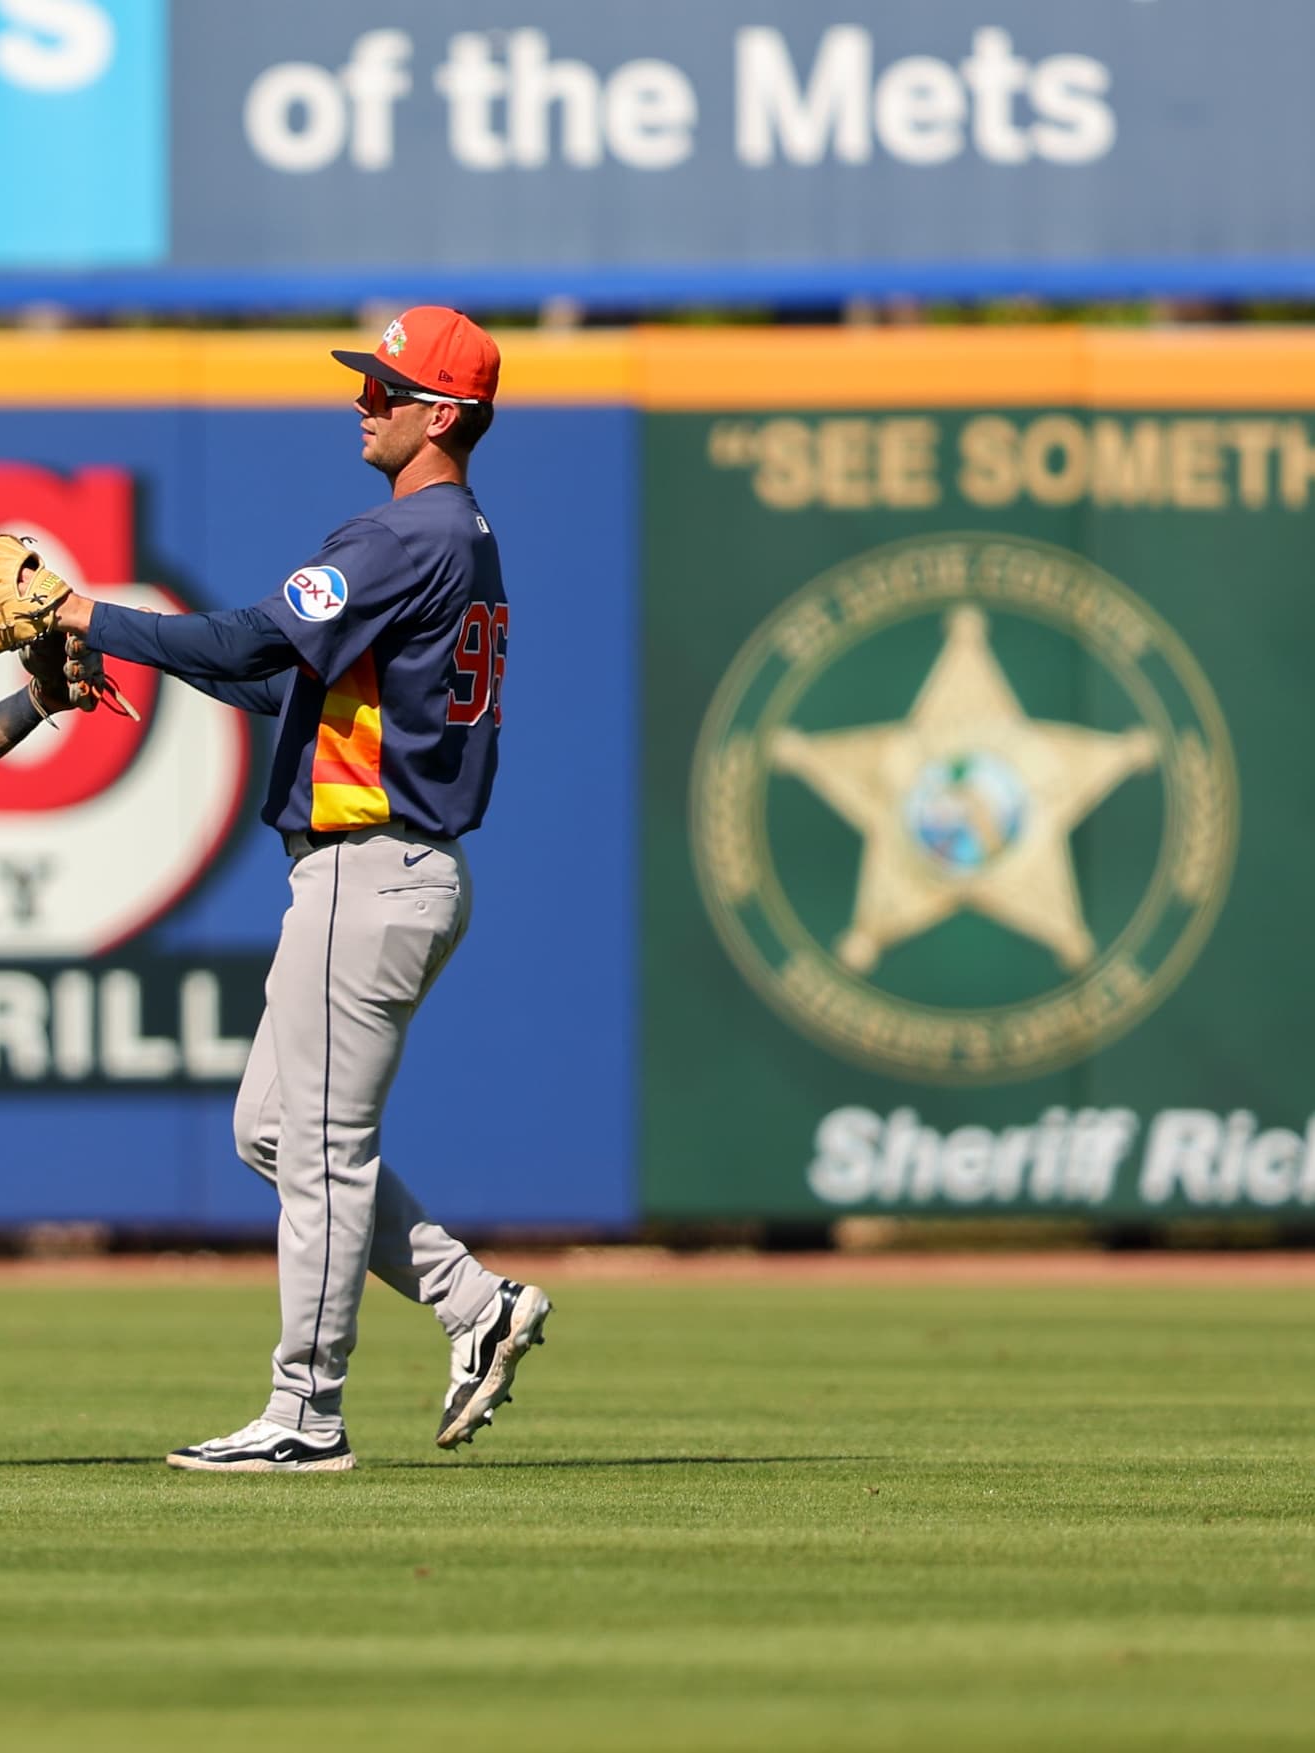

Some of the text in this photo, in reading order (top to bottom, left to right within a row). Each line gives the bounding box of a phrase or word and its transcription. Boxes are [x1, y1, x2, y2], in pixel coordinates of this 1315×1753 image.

[243, 23, 1118, 172] of the Mets
[292, 573, 340, 610] OXY
[807, 1106, 1140, 1203] Sheriff
